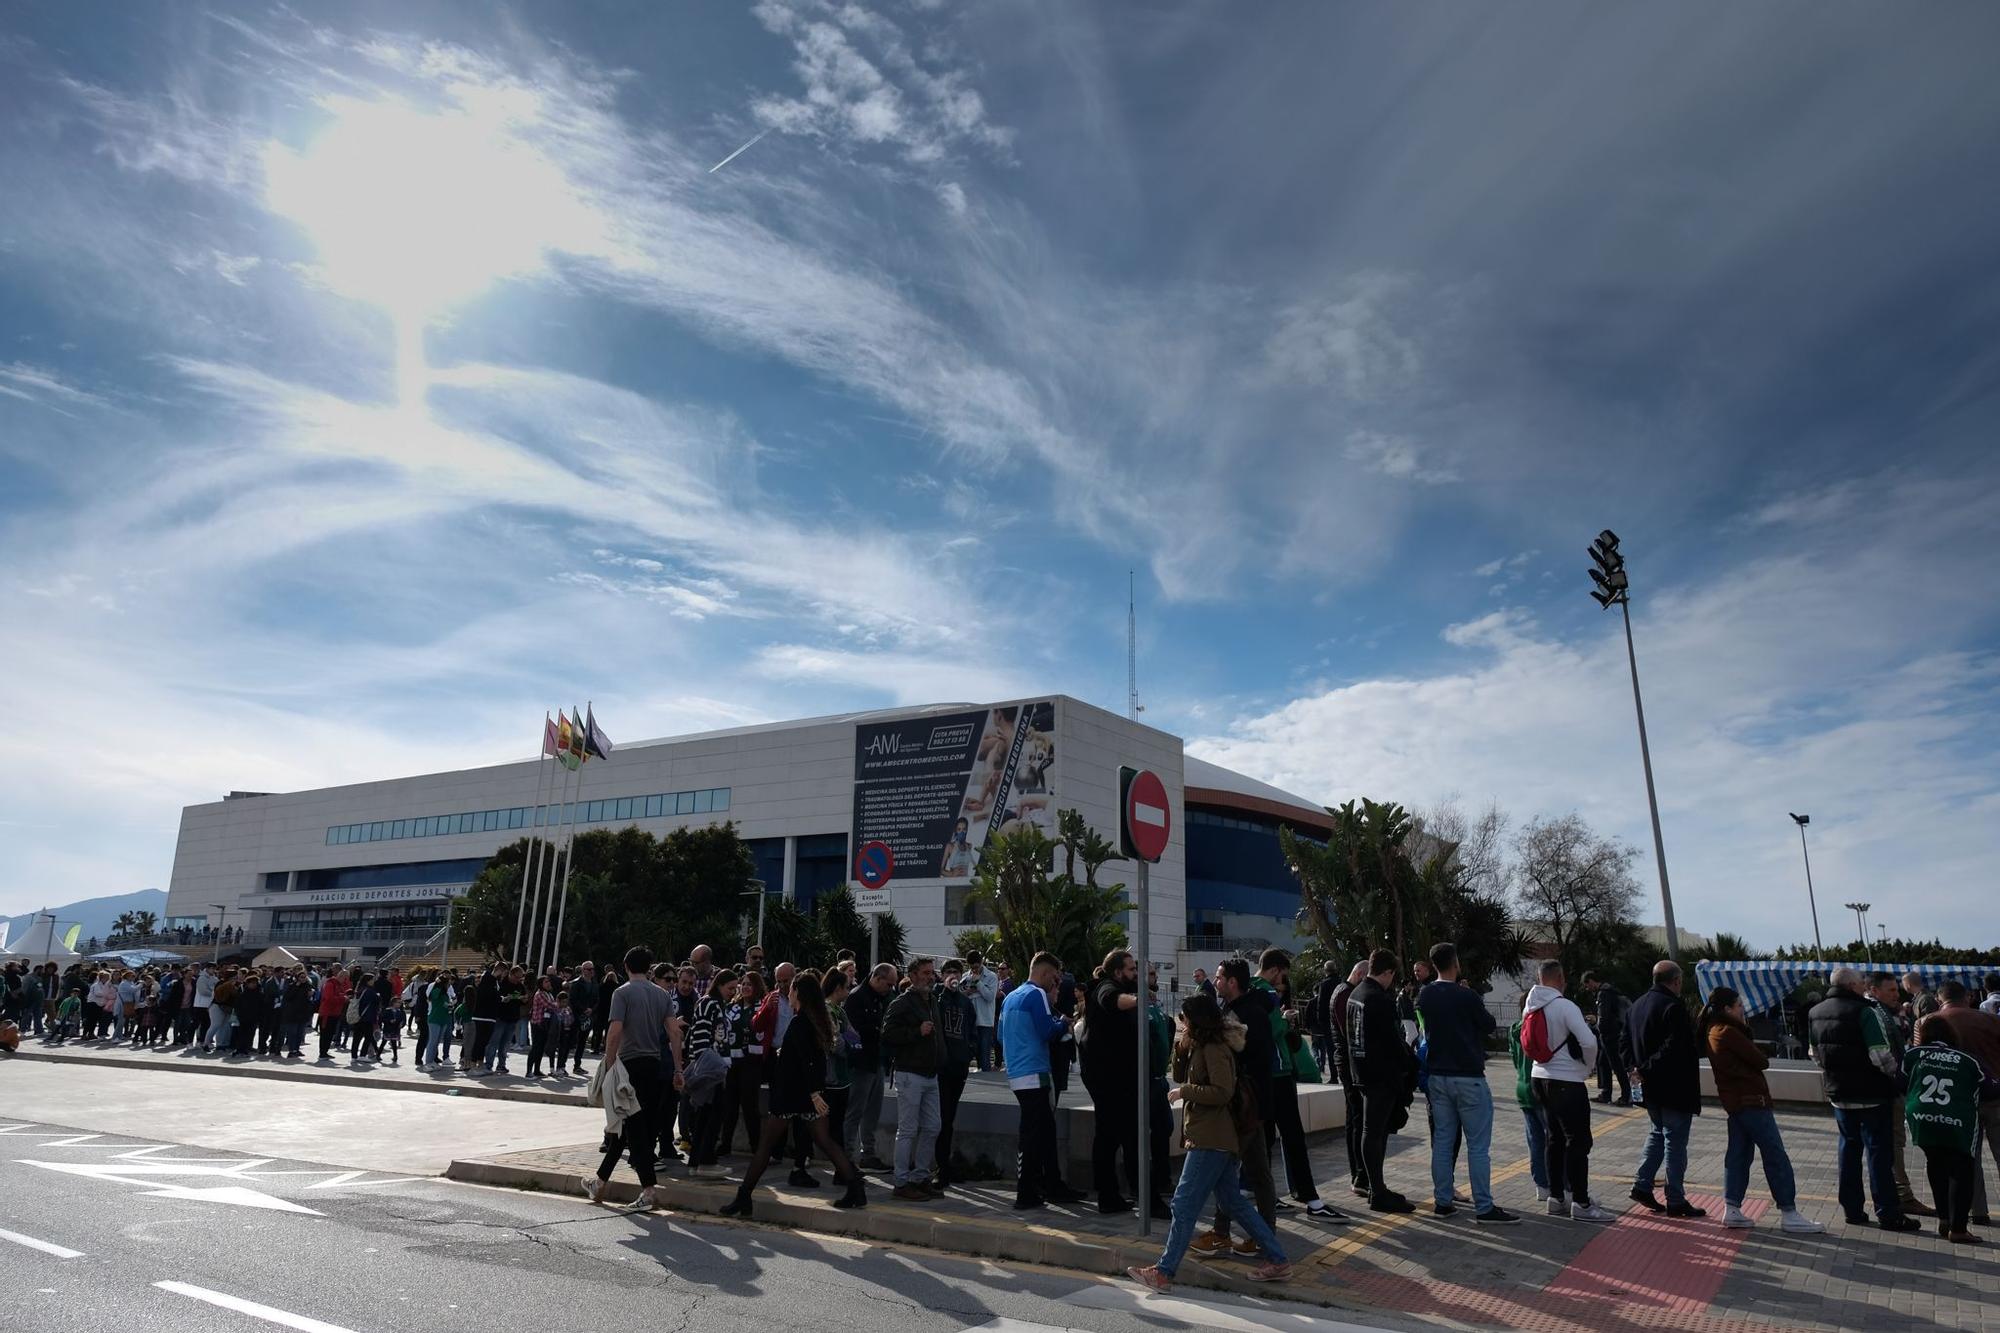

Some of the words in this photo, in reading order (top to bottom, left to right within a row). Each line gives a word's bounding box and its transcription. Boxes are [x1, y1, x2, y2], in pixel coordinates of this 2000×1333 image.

[864, 733, 902, 756] AMS
[1005, 767, 1013, 782] ES
[1009, 715, 1029, 767] MEDICINA
[311, 893, 345, 902] PALACIO
[350, 892, 360, 900] DE
[365, 889, 411, 899] DEPORTES
[944, 1007, 968, 1035] 17
[1919, 1074, 1954, 1106] 25
[1913, 1112, 1962, 1127] worten
